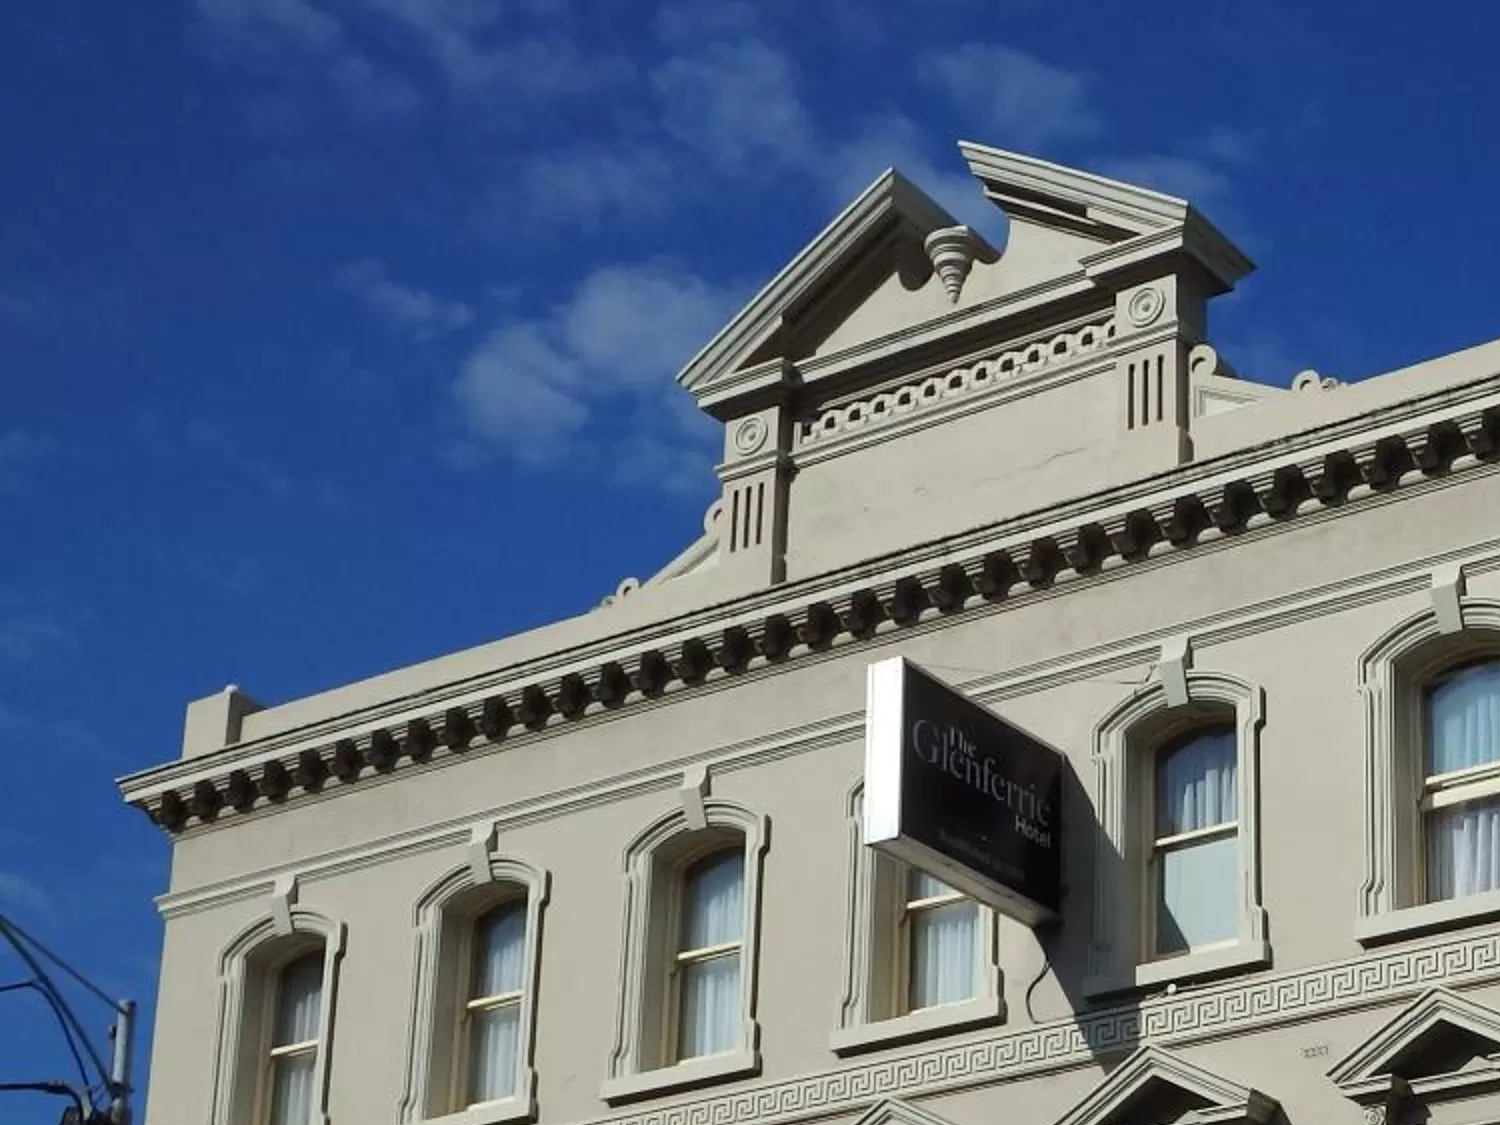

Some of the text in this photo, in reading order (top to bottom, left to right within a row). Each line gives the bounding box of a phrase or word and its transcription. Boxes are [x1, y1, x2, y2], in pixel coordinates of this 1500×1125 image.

[950, 725, 976, 756] The
[912, 719, 1050, 827] Glenferrie
[1015, 814, 1051, 849] Hotel
